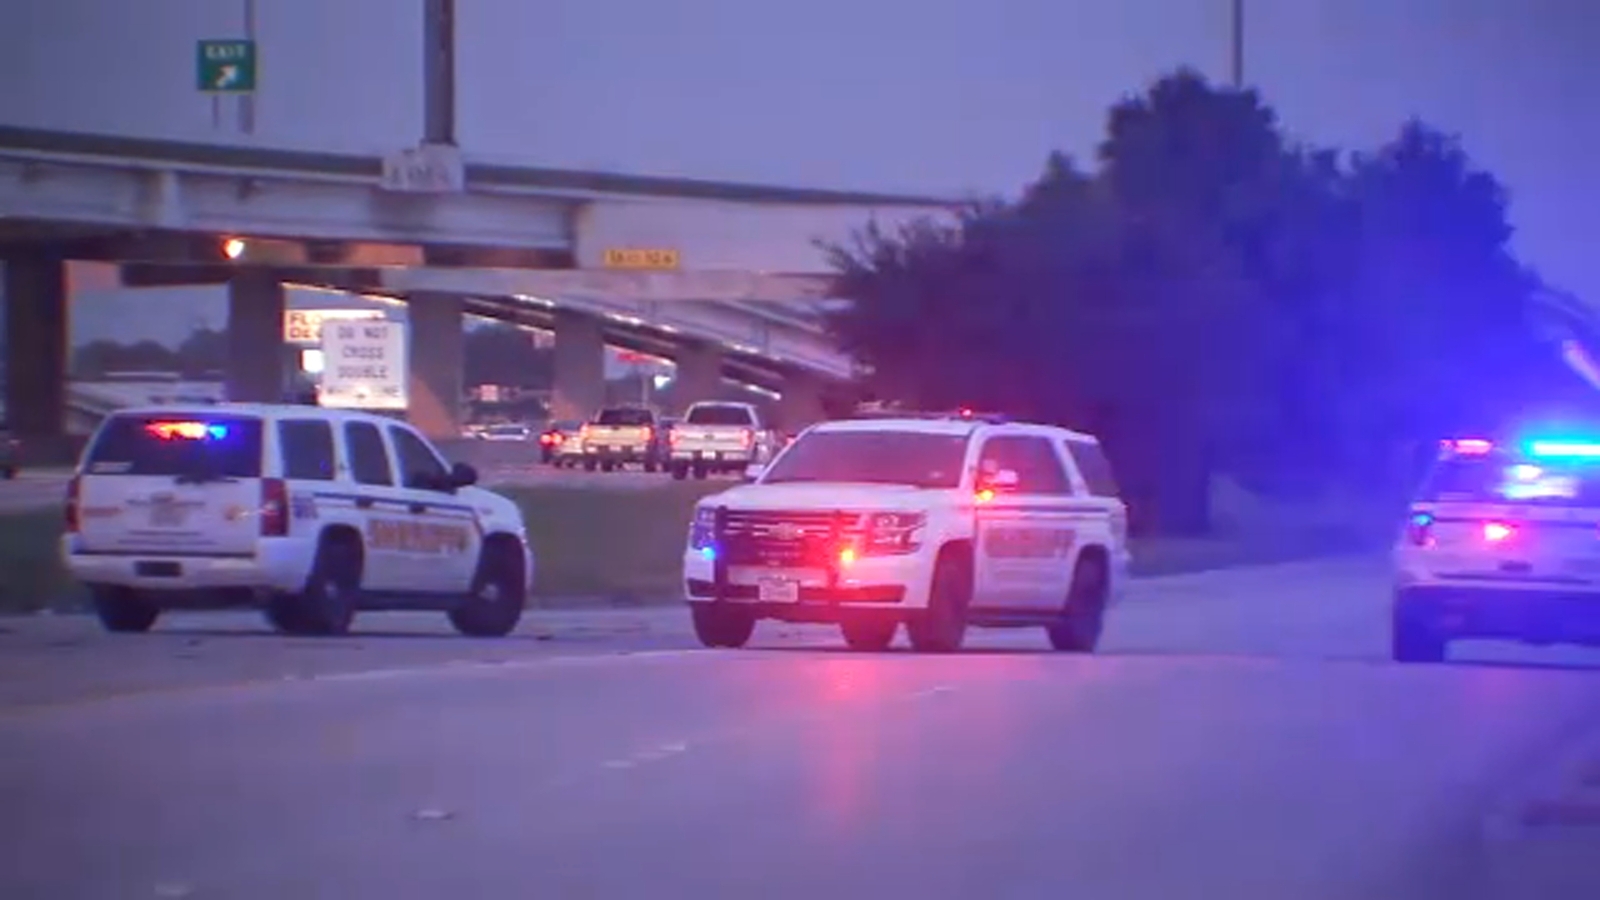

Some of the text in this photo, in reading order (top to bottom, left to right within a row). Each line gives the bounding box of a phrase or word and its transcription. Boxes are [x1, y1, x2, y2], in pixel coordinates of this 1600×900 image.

[205, 44, 246, 59] EXIT
[338, 326, 388, 339] DO NOT
[342, 346, 385, 359] CROSS
[337, 365, 388, 378] DOUBLE
